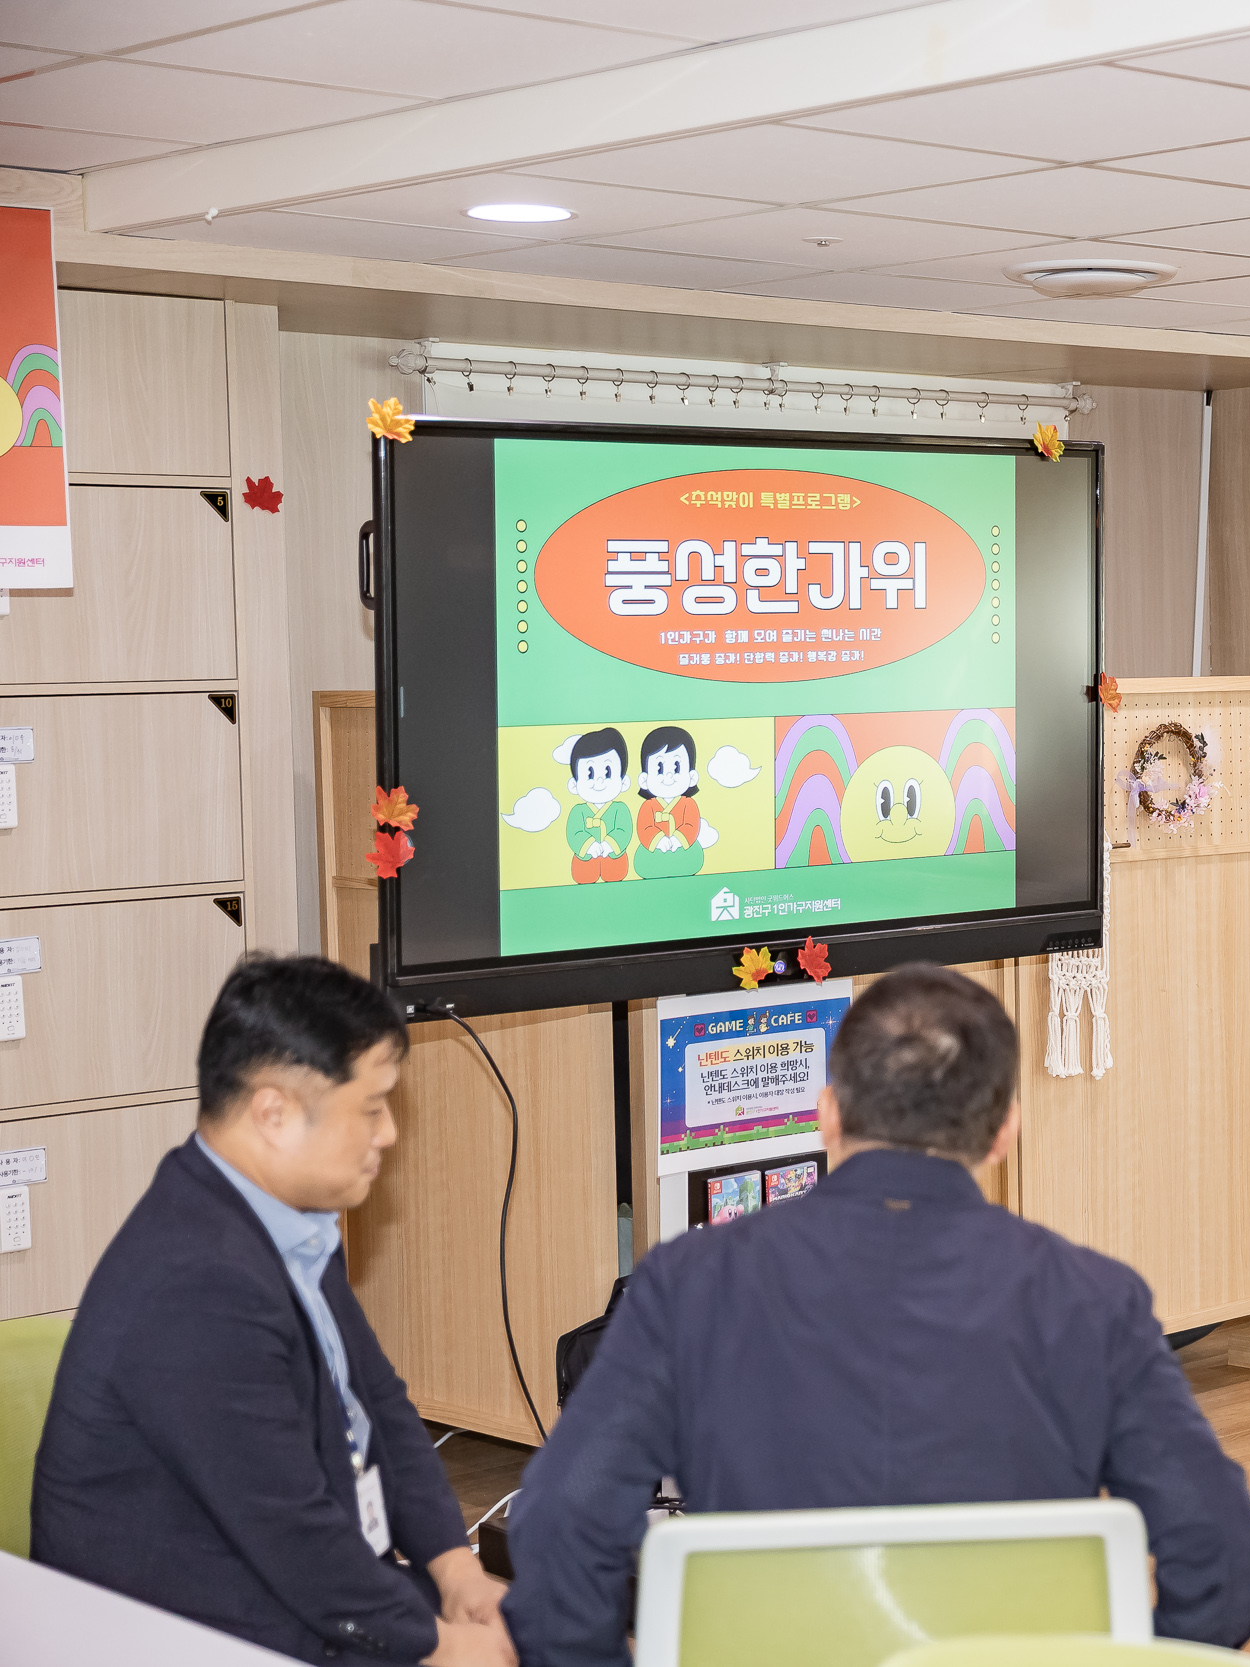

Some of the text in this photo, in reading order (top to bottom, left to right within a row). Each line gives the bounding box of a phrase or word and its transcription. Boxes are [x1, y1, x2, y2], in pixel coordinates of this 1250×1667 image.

[217, 496, 224, 506] 5
[680, 490, 861, 510] <추석맞이 특별프로그램>
[604, 537, 927, 616] 풍성한가위
[659, 629, 717, 646] 1인가구가
[724, 628, 750, 645] 함께
[753, 629, 777, 643] 모여
[781, 629, 817, 644] 즐기는
[859, 628, 882, 642] 시간
[678, 649, 865, 666] 즐거움 증가! 단합력 증가! 행복감 증가!
[220, 698, 232, 708] 10
[226, 900, 238, 911] 15
[744, 898, 841, 919] 광진구 1인가구지원센터
[708, 1012, 803, 1035] GAME CAFE
[697, 1040, 815, 1067] 닌텐도 스위치 이용 가능
[700, 1058, 810, 1083] 닌텐도 스위치 이용 희망시,
[704, 1071, 809, 1096] 안내데스크에 말해주세요!
